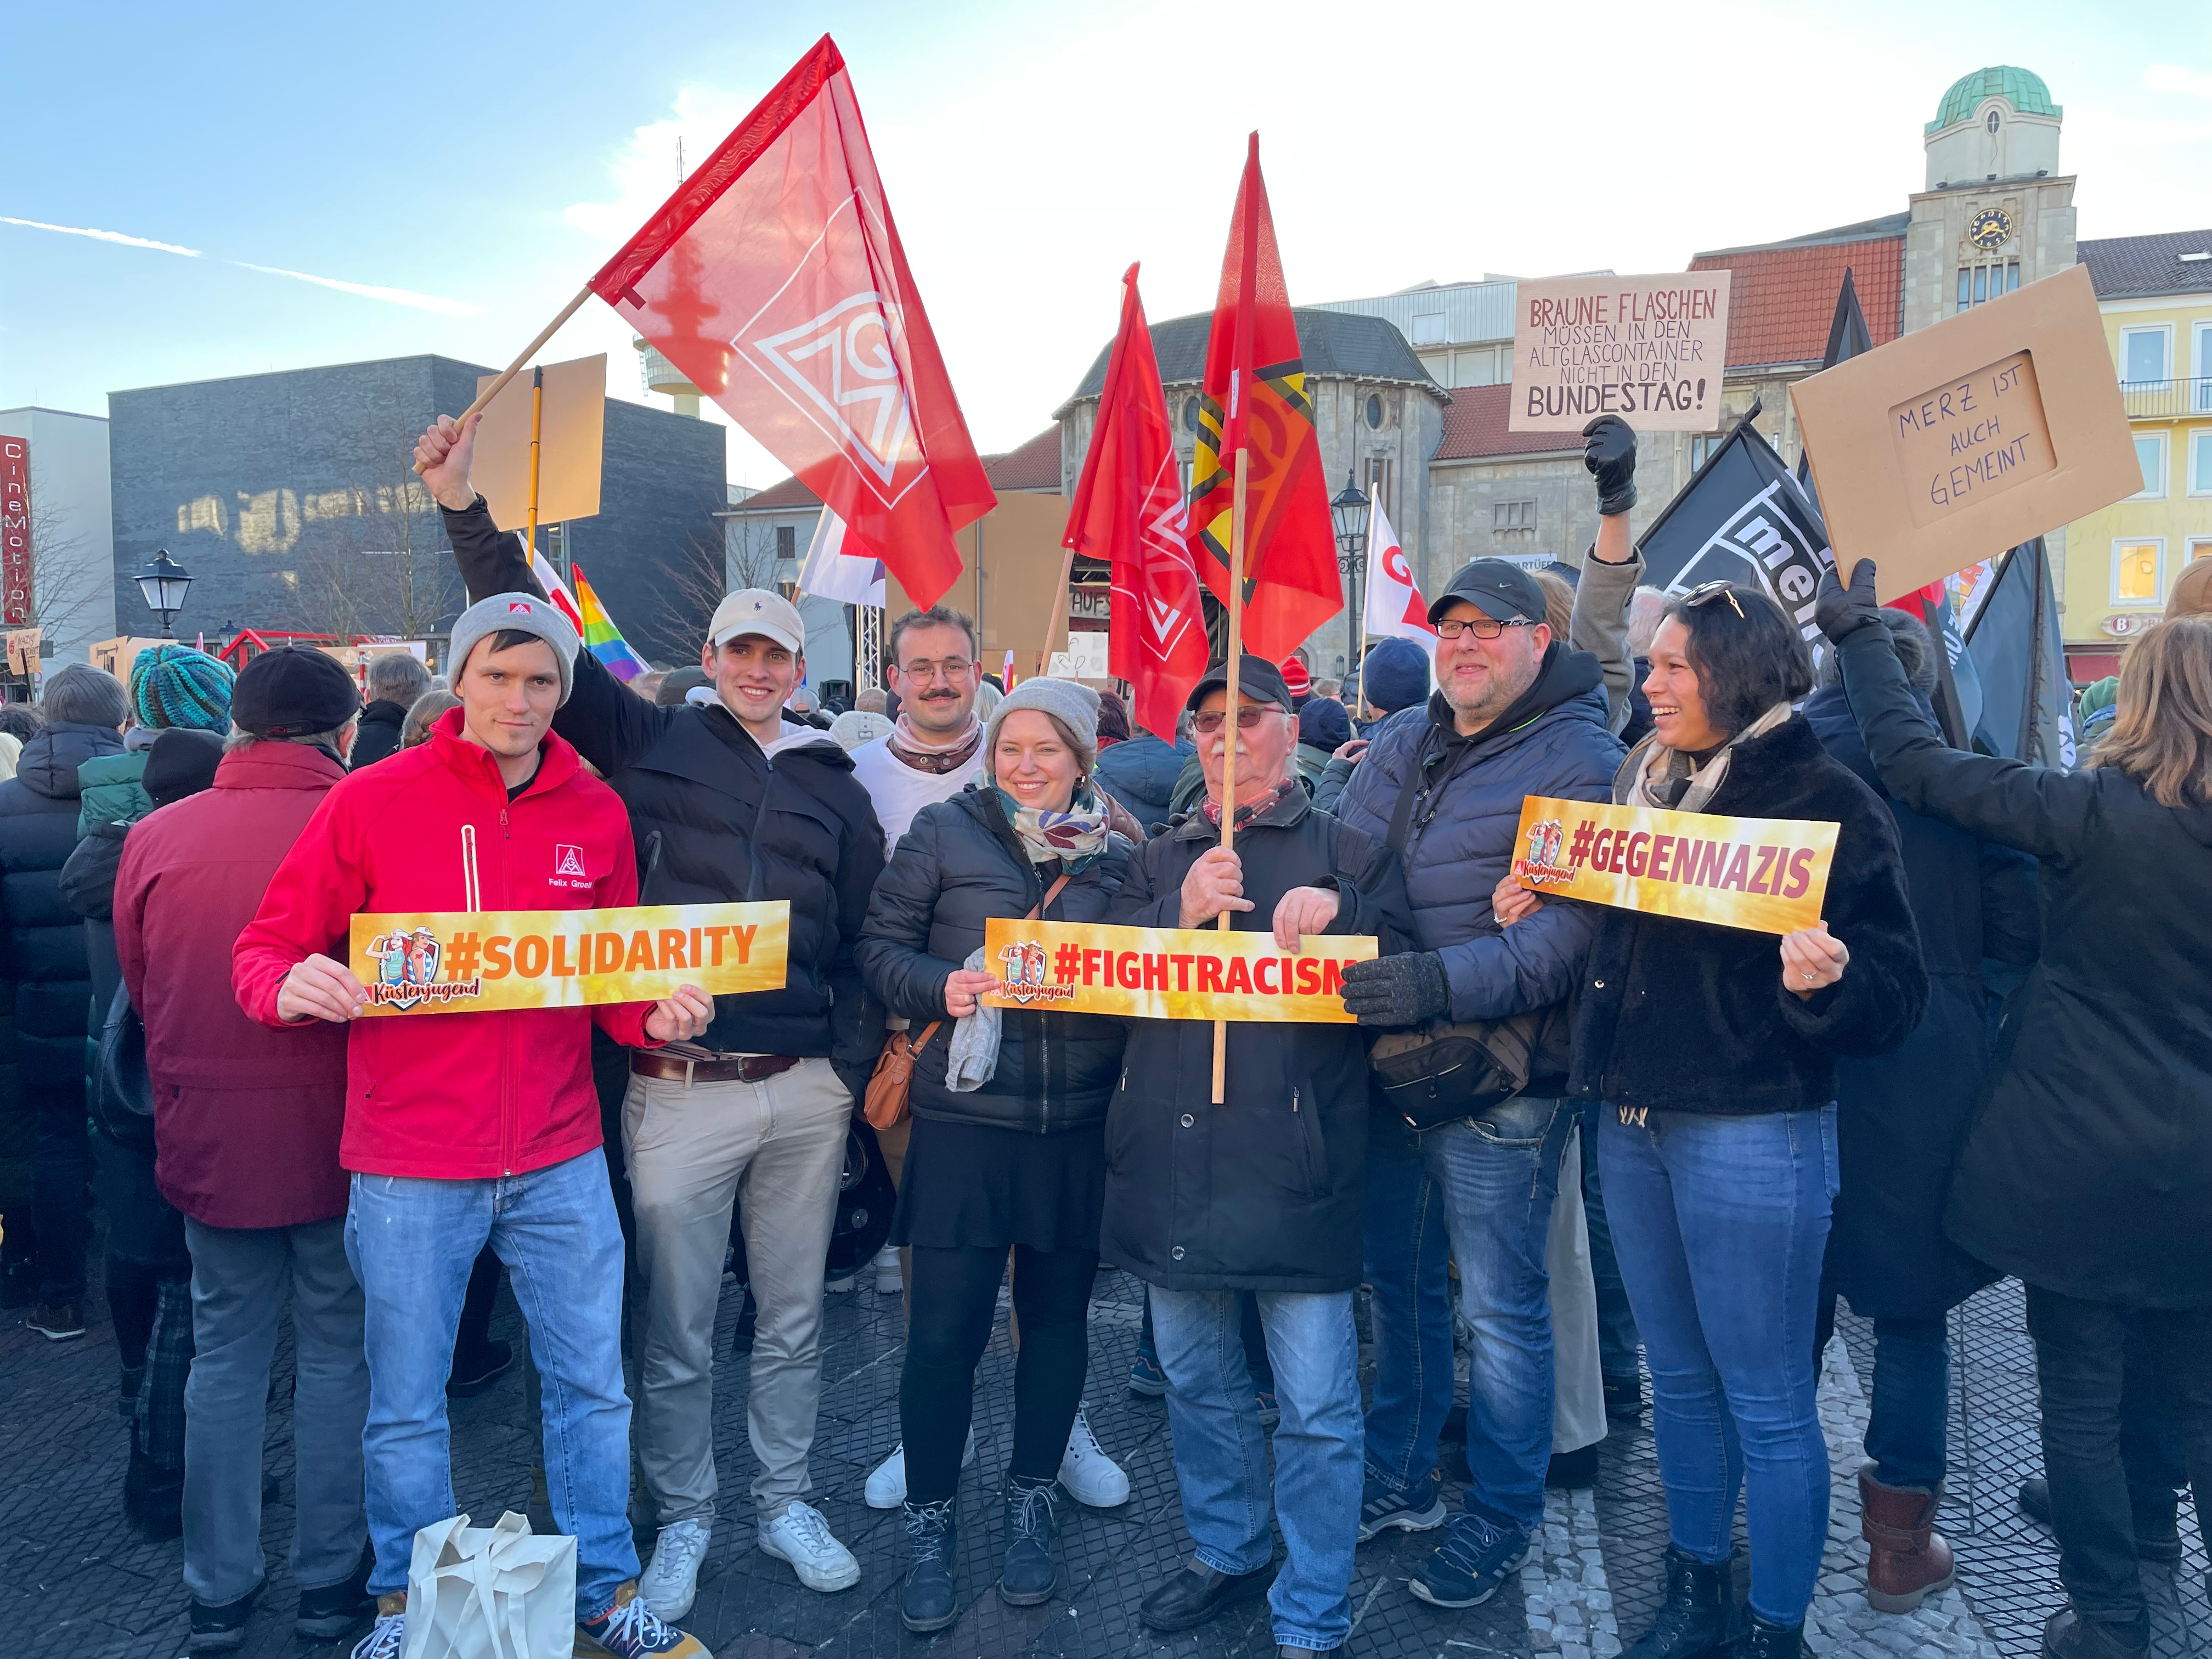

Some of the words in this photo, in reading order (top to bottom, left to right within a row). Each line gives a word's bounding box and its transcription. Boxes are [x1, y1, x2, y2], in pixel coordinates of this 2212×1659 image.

[1531, 295, 1607, 328] BRAUNE
[1619, 289, 1716, 324] FLASCHEN
[1544, 324, 1616, 346] MÜSSEN
[1628, 322, 1646, 341] IN
[1655, 320, 1690, 339] DEN
[1529, 340, 1703, 368] ALTGLASCONTAINER
[1560, 365, 1611, 383] NICHT
[1617, 365, 1632, 382] IN
[1640, 363, 1677, 381] DEN
[1527, 378, 1706, 417] BUNDESTAG!
[1900, 383, 1977, 438] MERZ
[1993, 363, 2023, 398] IST
[1951, 415, 2000, 456] AUCH
[1931, 433, 2030, 505] GEMEINT
[5, 443, 27, 619] CineMotion
[1523, 859, 1576, 883] Küstenjugend
[1568, 820, 1815, 899] #GEGENNAZIS
[549, 878, 568, 887] Felix
[445, 924, 758, 981] #SOLIDARITY
[1054, 943, 1358, 996] #FIGHTRACISM
[374, 977, 480, 1005] Küstenjugend
[1002, 980, 1075, 1001] Küstenjugend
